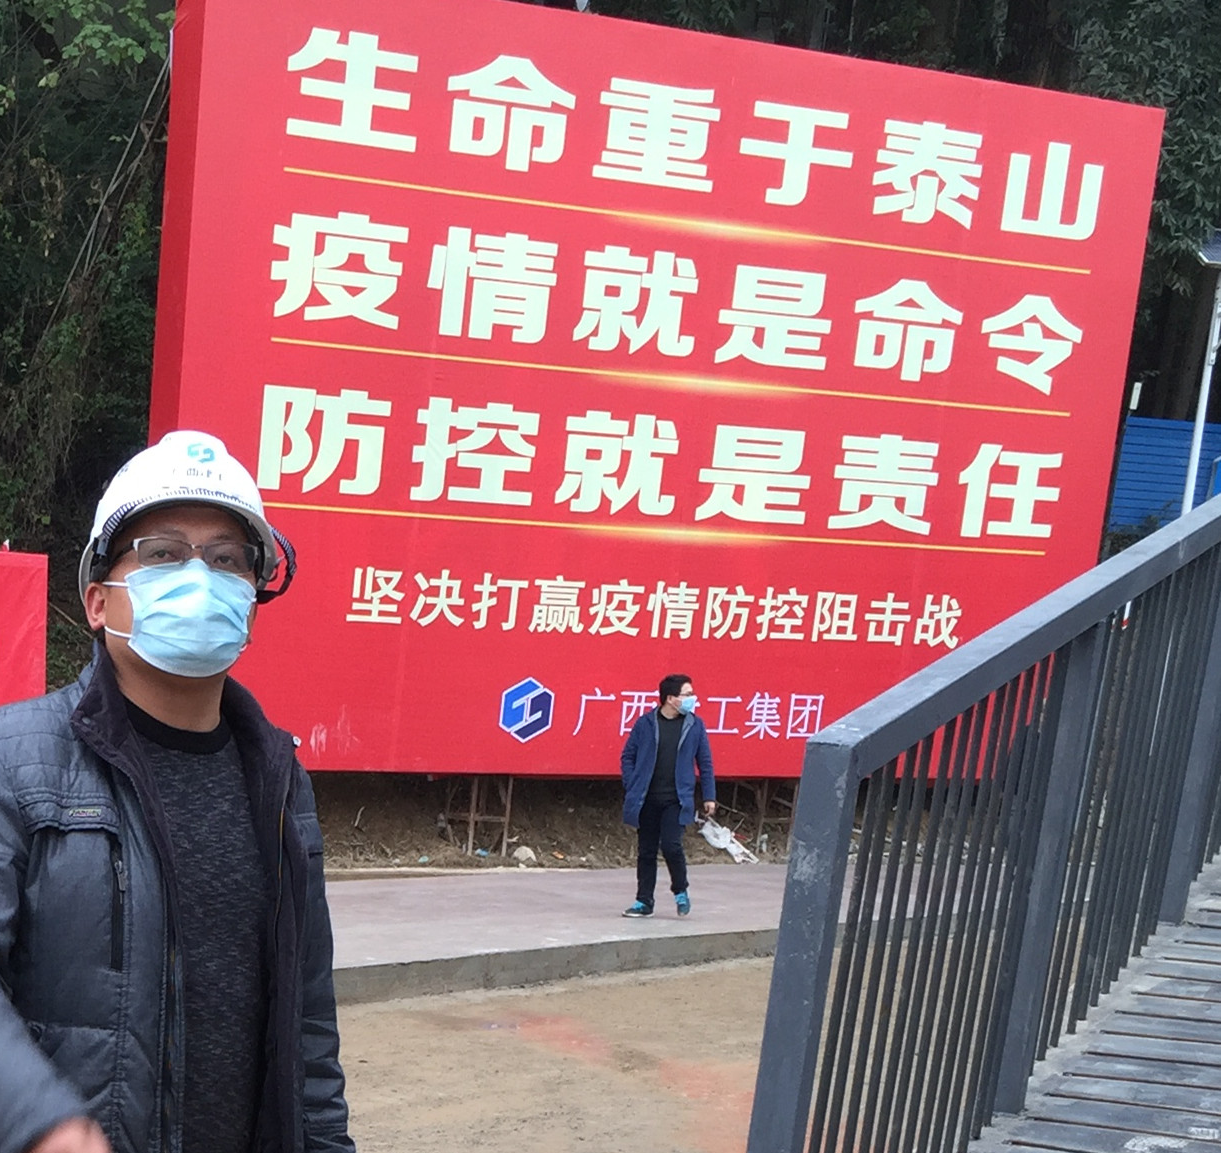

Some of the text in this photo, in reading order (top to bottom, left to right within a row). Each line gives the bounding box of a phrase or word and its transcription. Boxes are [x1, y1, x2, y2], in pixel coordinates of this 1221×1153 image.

[286, 26, 1105, 241] 生命重于泰山
[270, 211, 1084, 396] 疫情就是命令
[258, 384, 1064, 538] 防控就是责任
[346, 566, 963, 648] 坚决打赢疫情防控阻击战
[572, 687, 826, 741] 广西工集团
